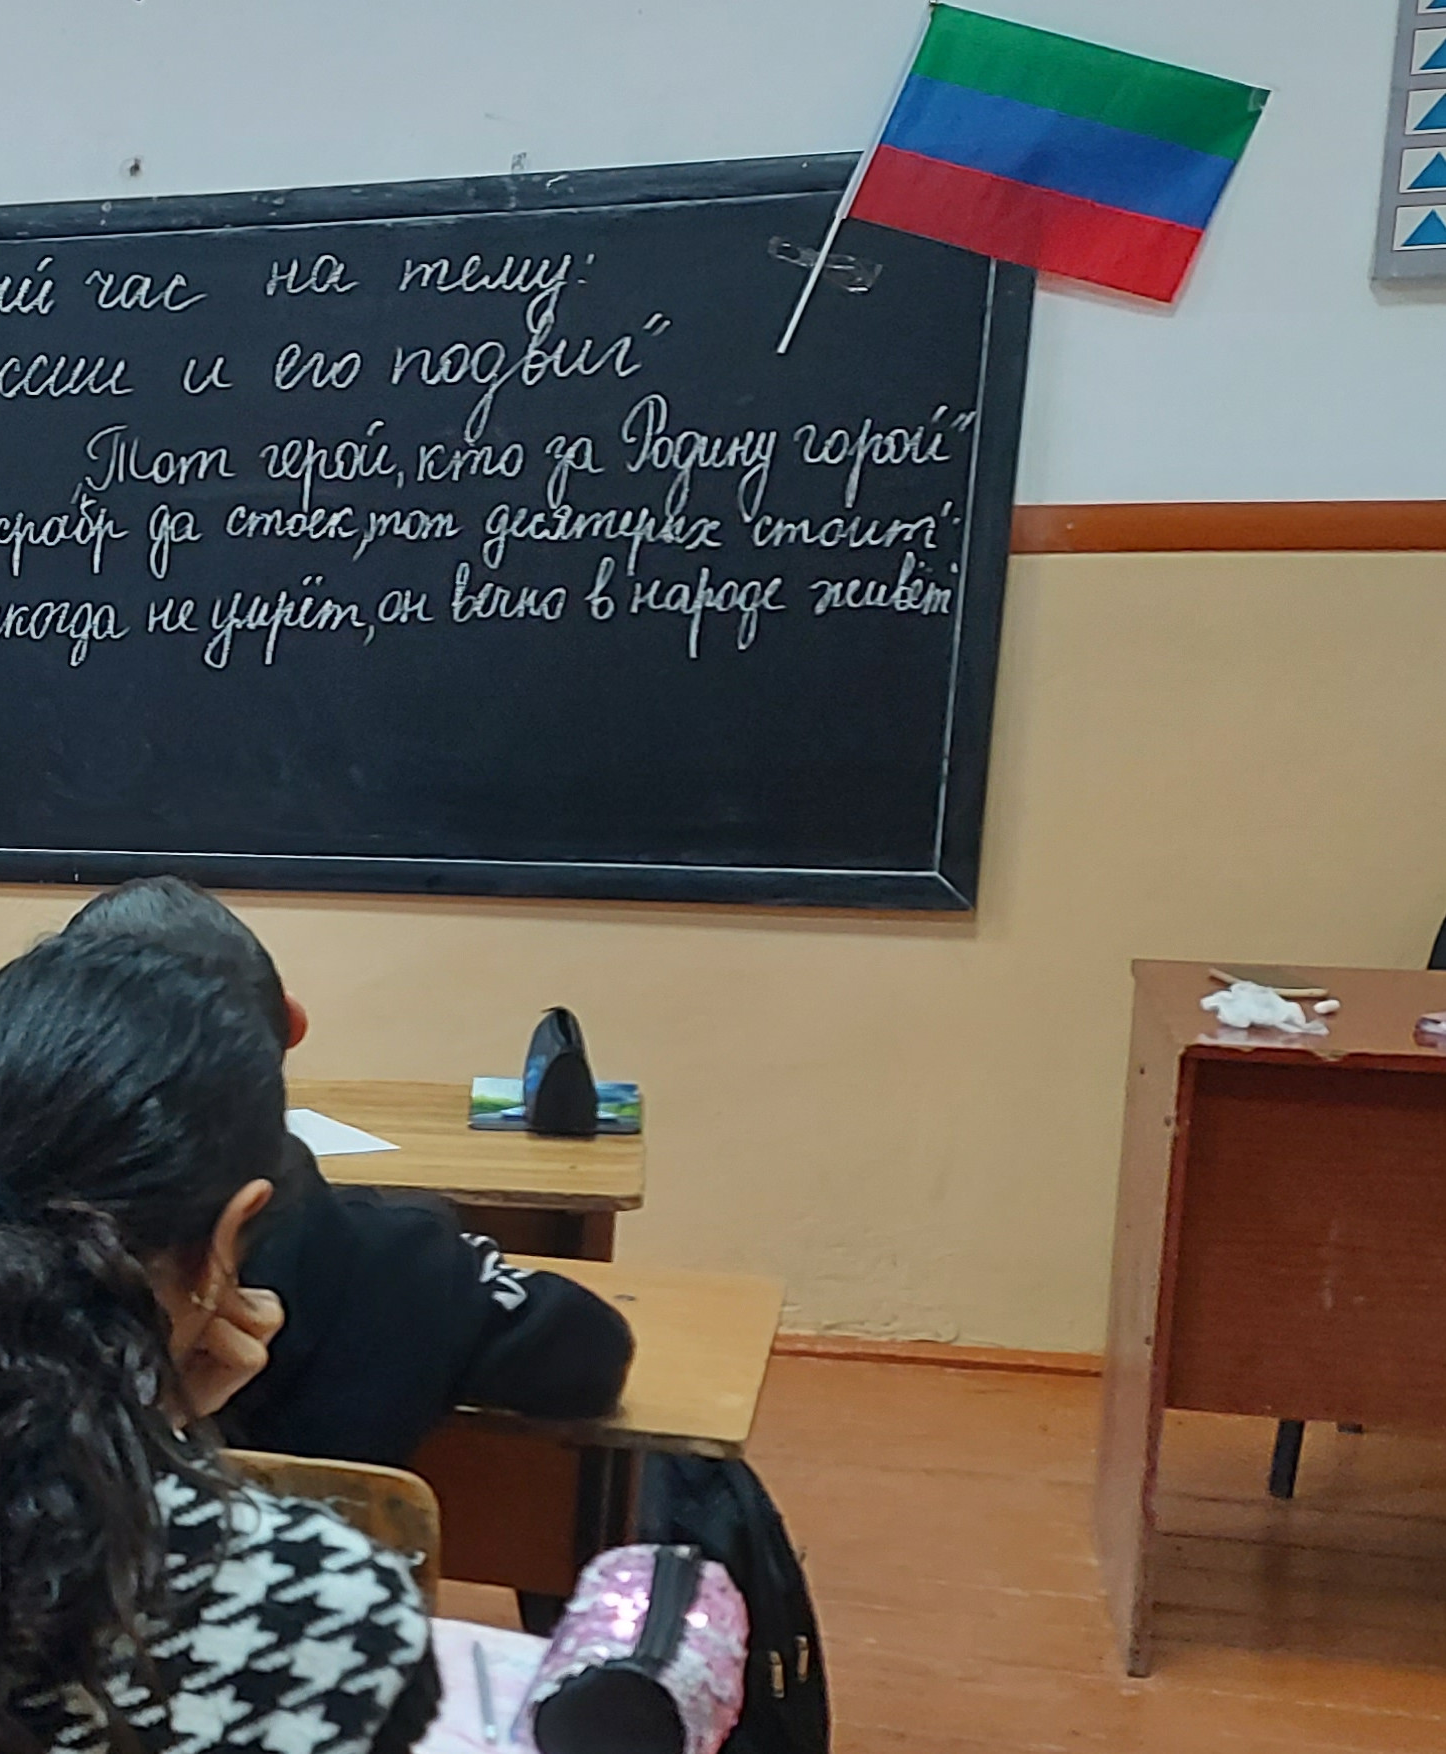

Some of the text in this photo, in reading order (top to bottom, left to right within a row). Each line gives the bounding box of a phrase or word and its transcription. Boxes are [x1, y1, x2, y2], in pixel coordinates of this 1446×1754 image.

[84, 268, 208, 311] час
[265, 253, 361, 296] на
[182, 357, 234, 395] и
[274, 344, 362, 390] его
[259, 419, 405, 513] герой,
[417, 443, 525, 482] кто
[545, 435, 605, 510] за
[621, 394, 778, 524] Родину
[149, 504, 204, 580] да
[482, 503, 724, 577] десятерых
[148, 596, 199, 632] не
[451, 562, 568, 623] вечно
[585, 556, 616, 621] в
[629, 566, 788, 660] народе
